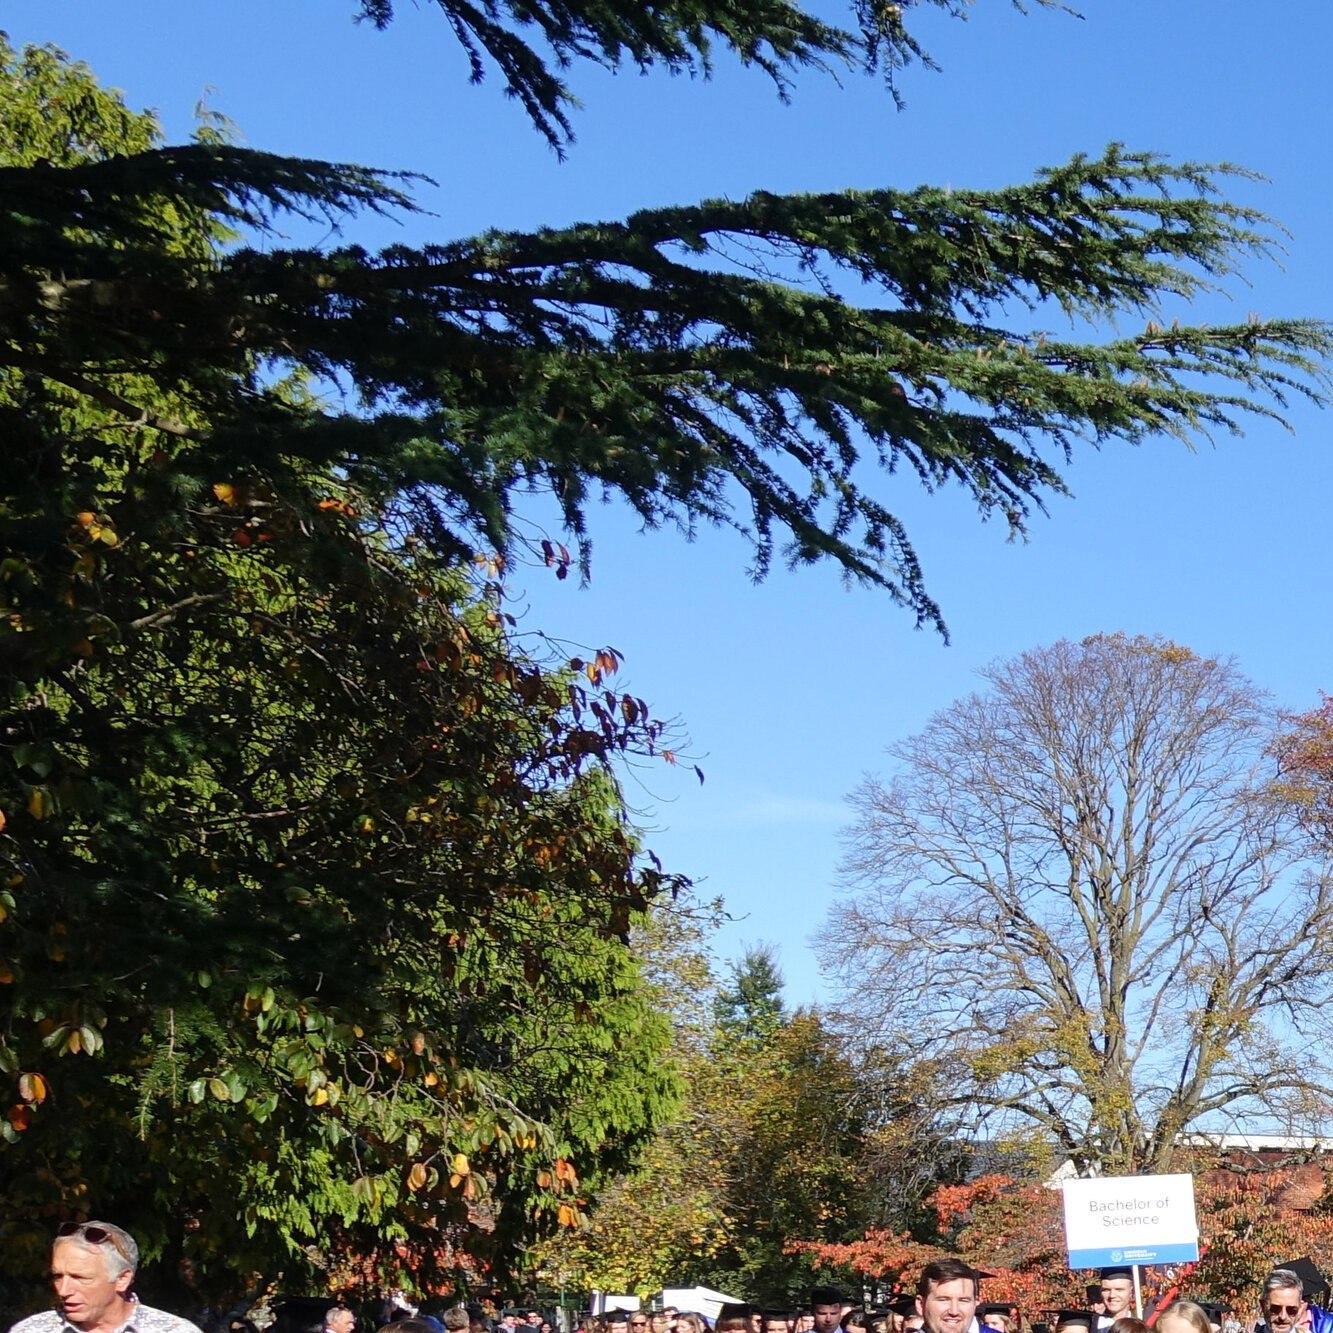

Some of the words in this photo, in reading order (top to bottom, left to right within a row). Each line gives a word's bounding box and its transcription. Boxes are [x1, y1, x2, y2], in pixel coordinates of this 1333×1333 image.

[1090, 1199, 1151, 1212] Bachelor
[1156, 1196, 1169, 1209] of
[1102, 1215, 1159, 1227] Science
